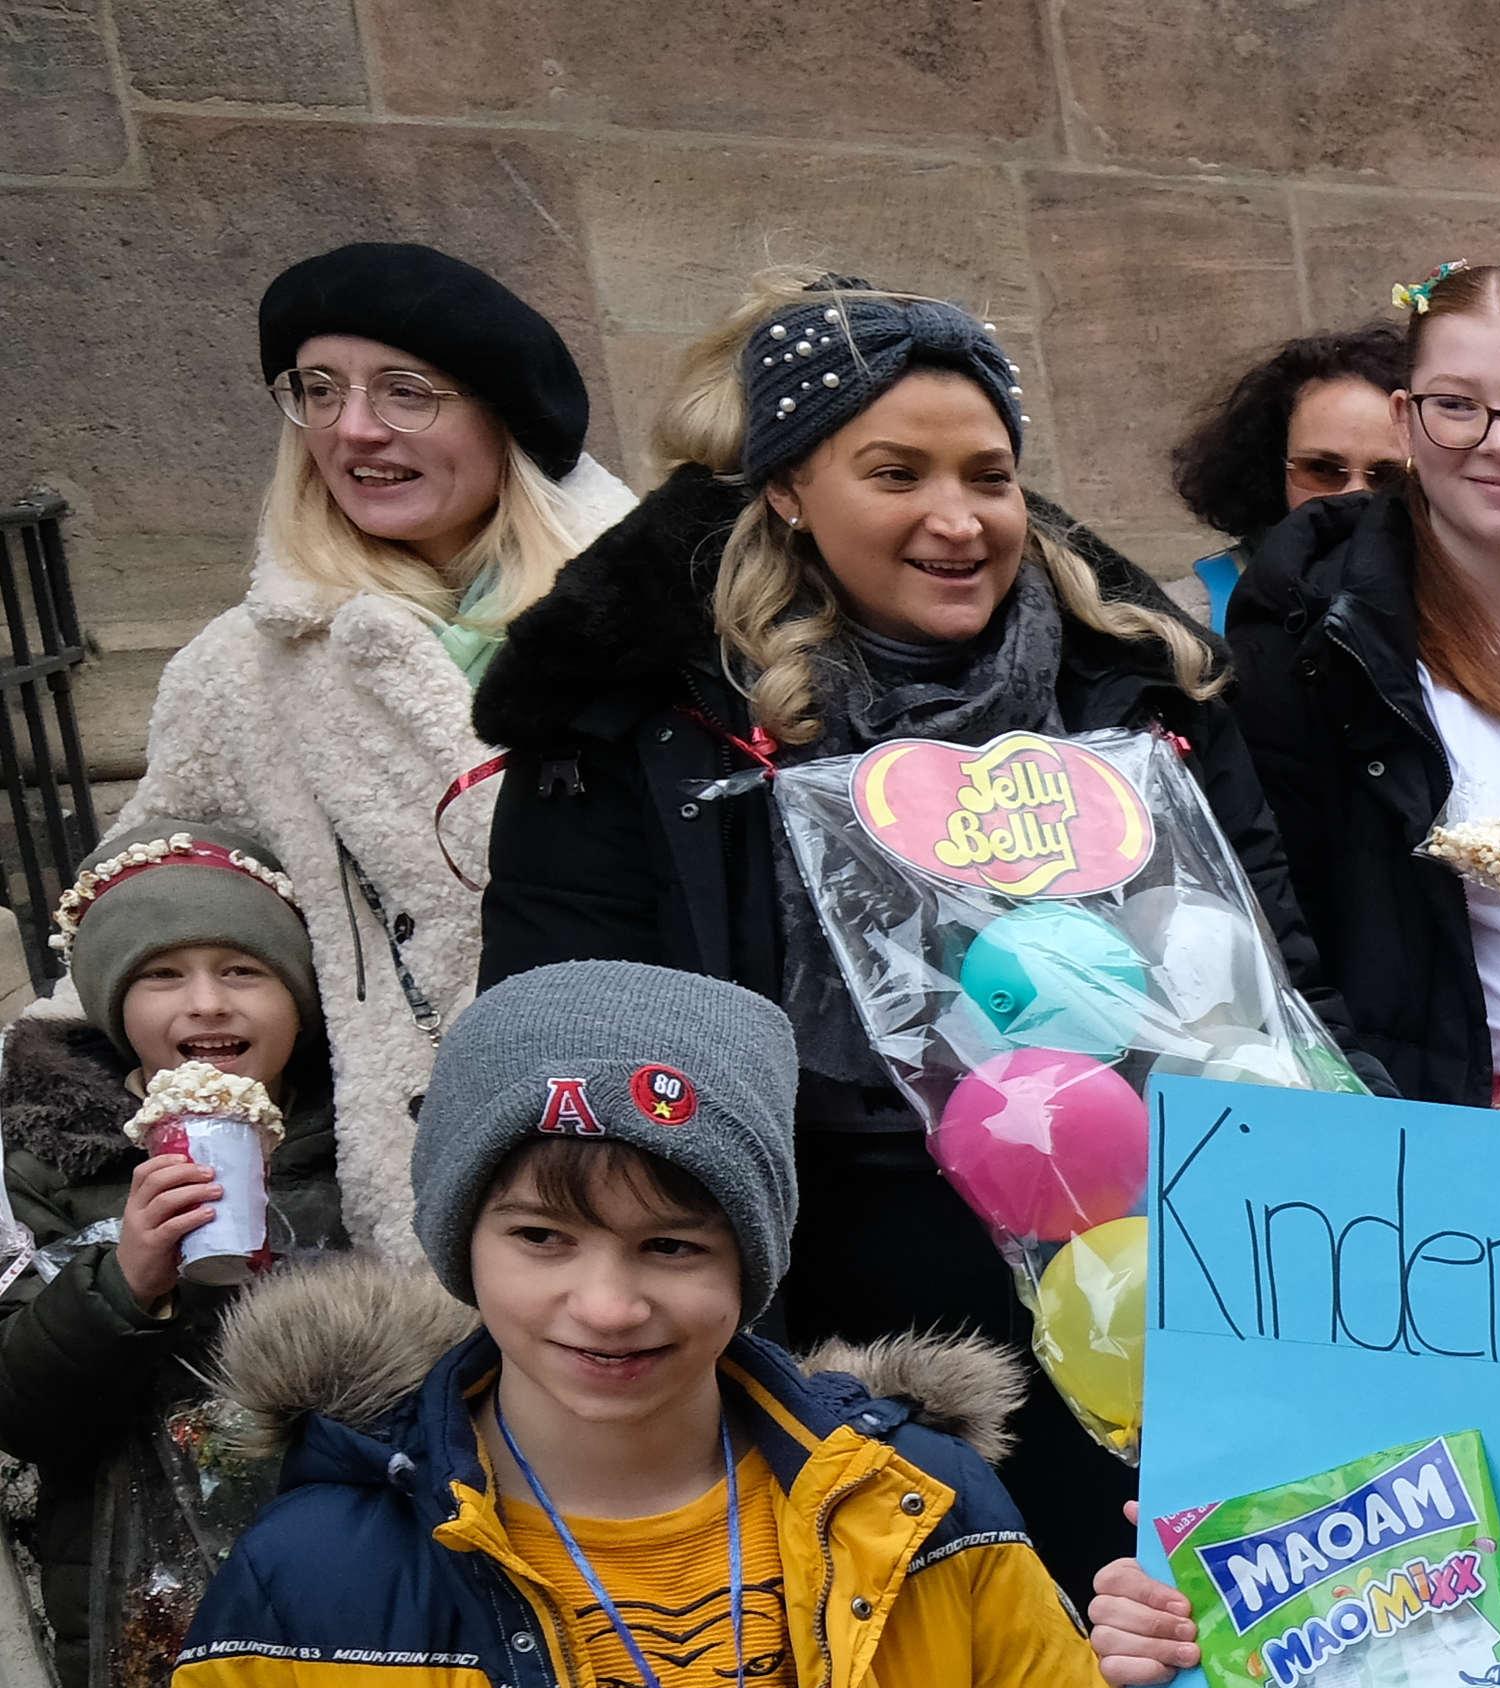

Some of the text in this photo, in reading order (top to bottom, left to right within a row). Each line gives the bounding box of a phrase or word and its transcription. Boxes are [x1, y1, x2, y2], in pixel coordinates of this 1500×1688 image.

[956, 756, 1076, 818] Jelly
[933, 806, 1078, 871] Belly
[538, 1072, 683, 1137] A 80
[1226, 1462, 1457, 1612] MAOAM
[209, 1640, 298, 1658] MOUNTAIN
[299, 1647, 322, 1660] 83
[332, 1648, 428, 1665] MOUNTAIN
